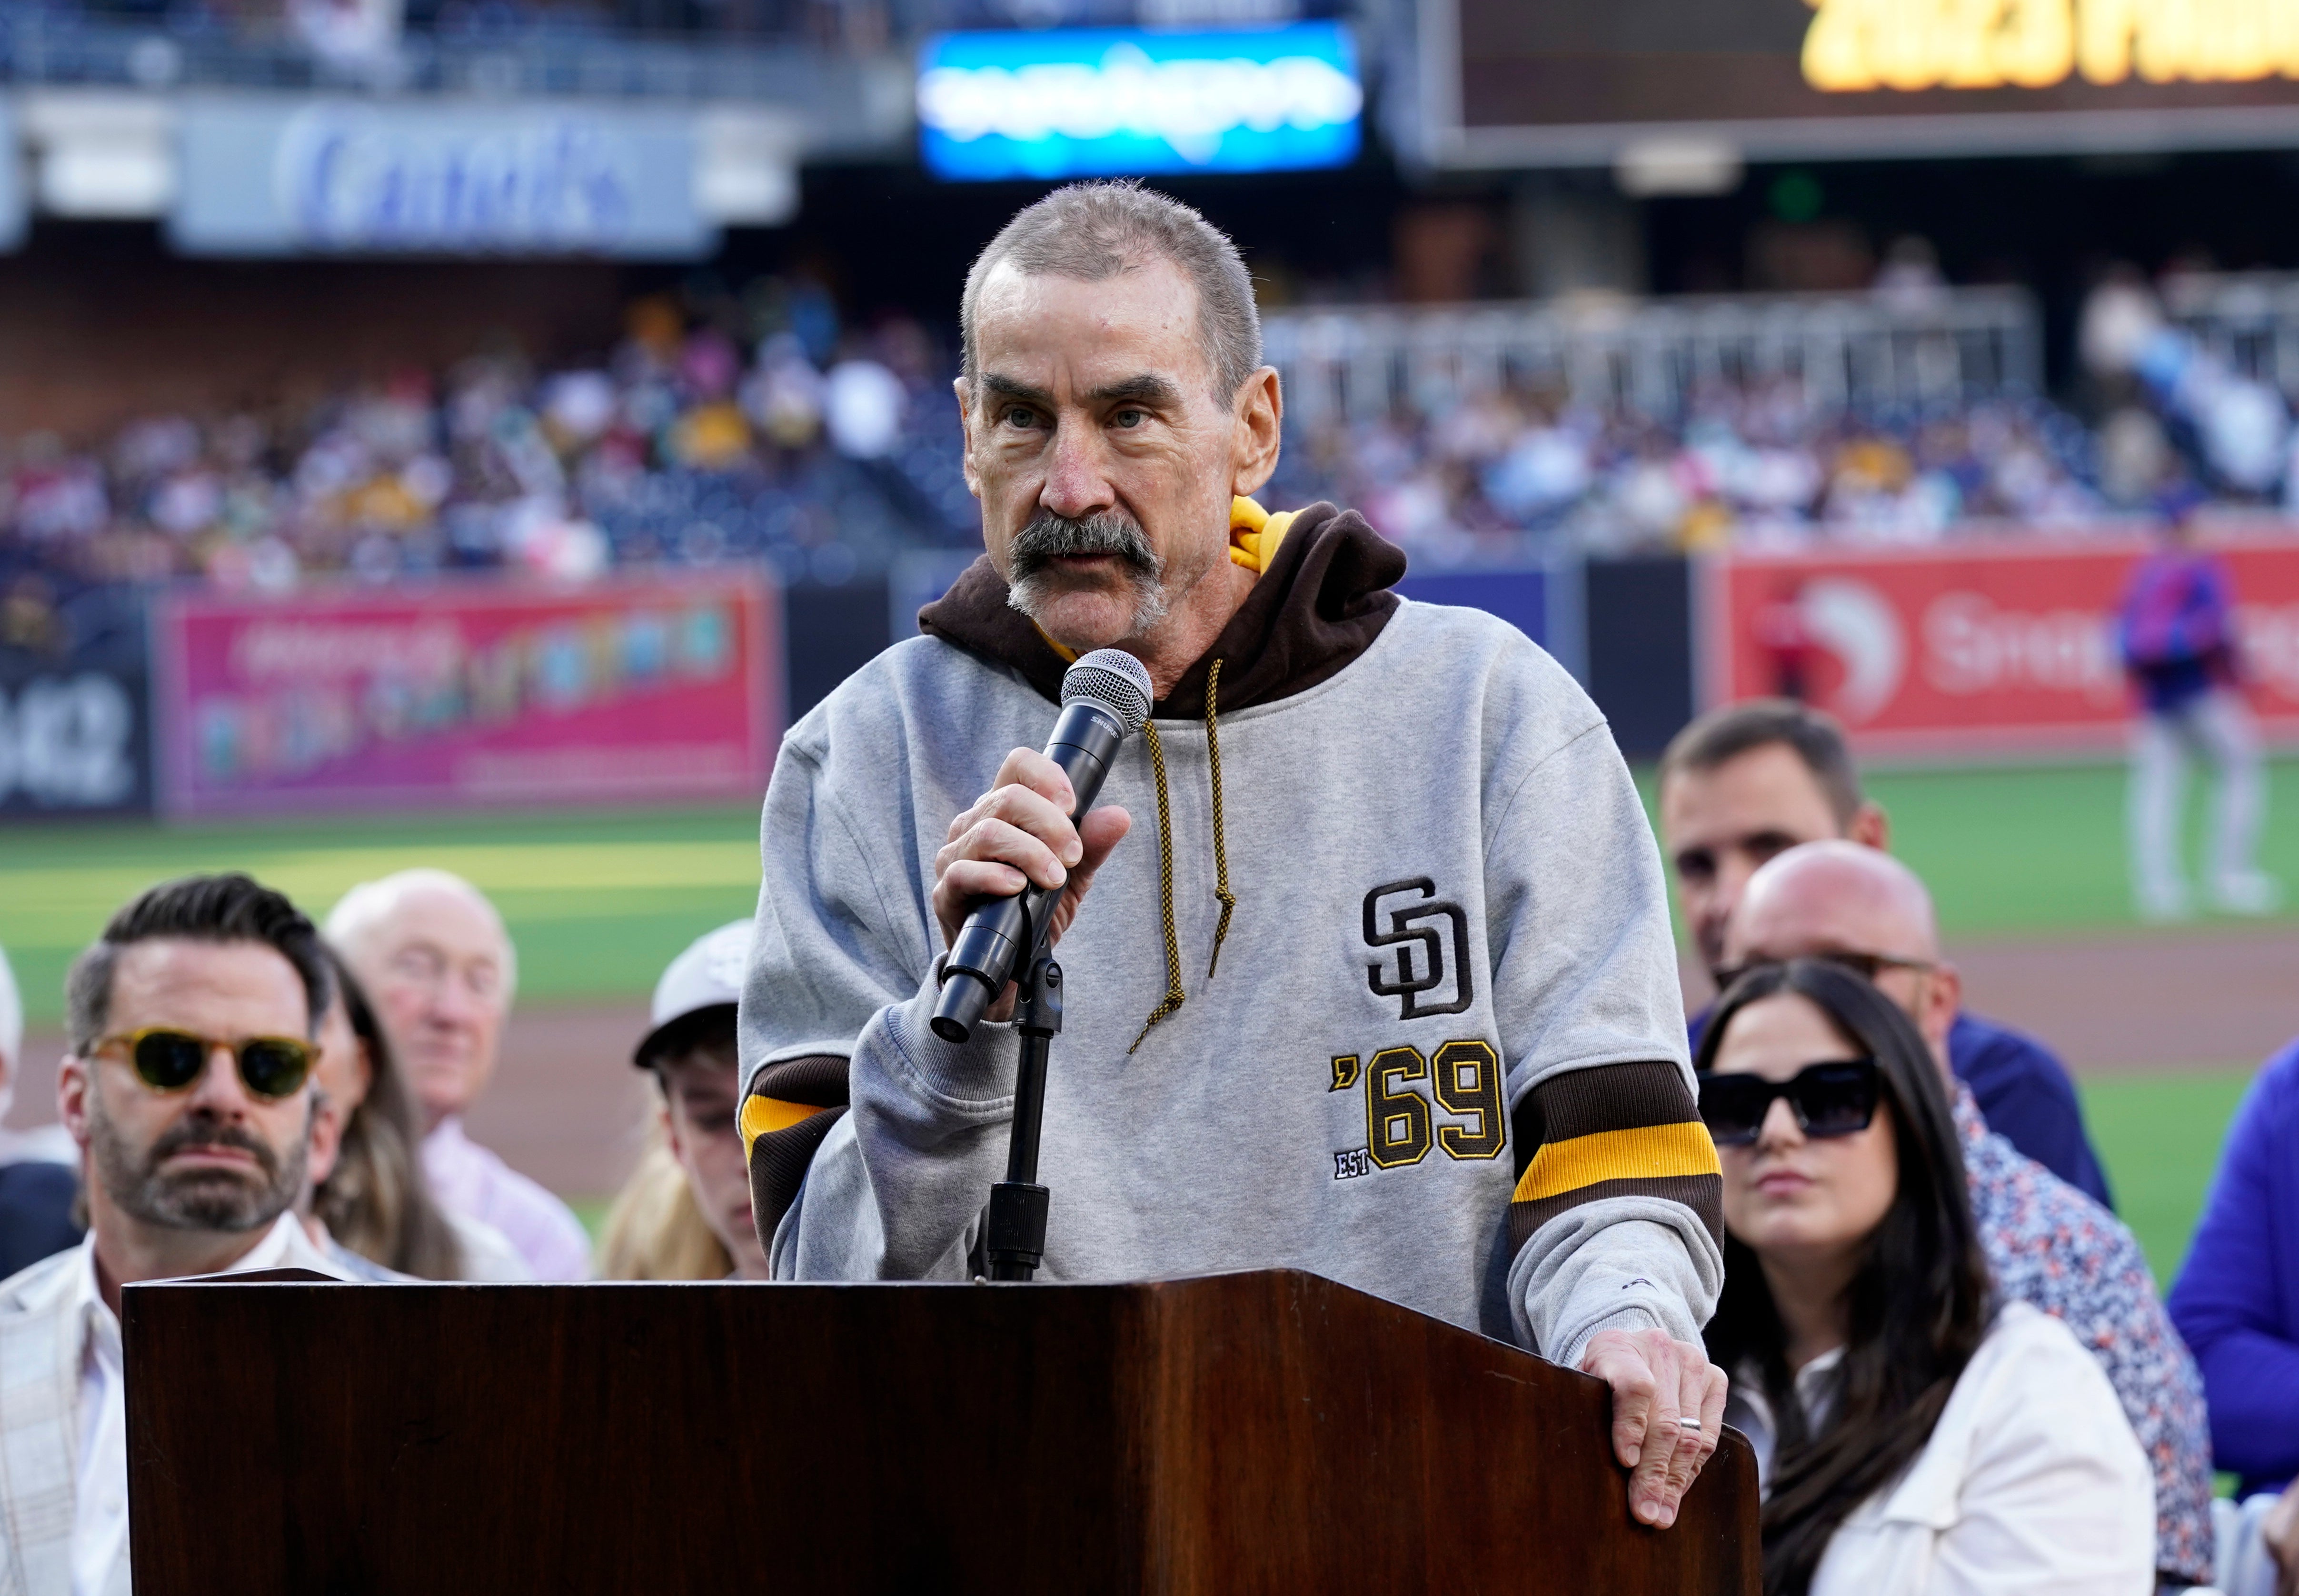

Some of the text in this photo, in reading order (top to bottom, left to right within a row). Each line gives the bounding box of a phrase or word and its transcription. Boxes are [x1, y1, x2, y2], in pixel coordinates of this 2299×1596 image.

[1090, 715, 1118, 738] SHURE
[1363, 877, 1473, 1020] SD
[1329, 1040, 1506, 1169] '69
[1334, 1147, 1369, 1180] EST
